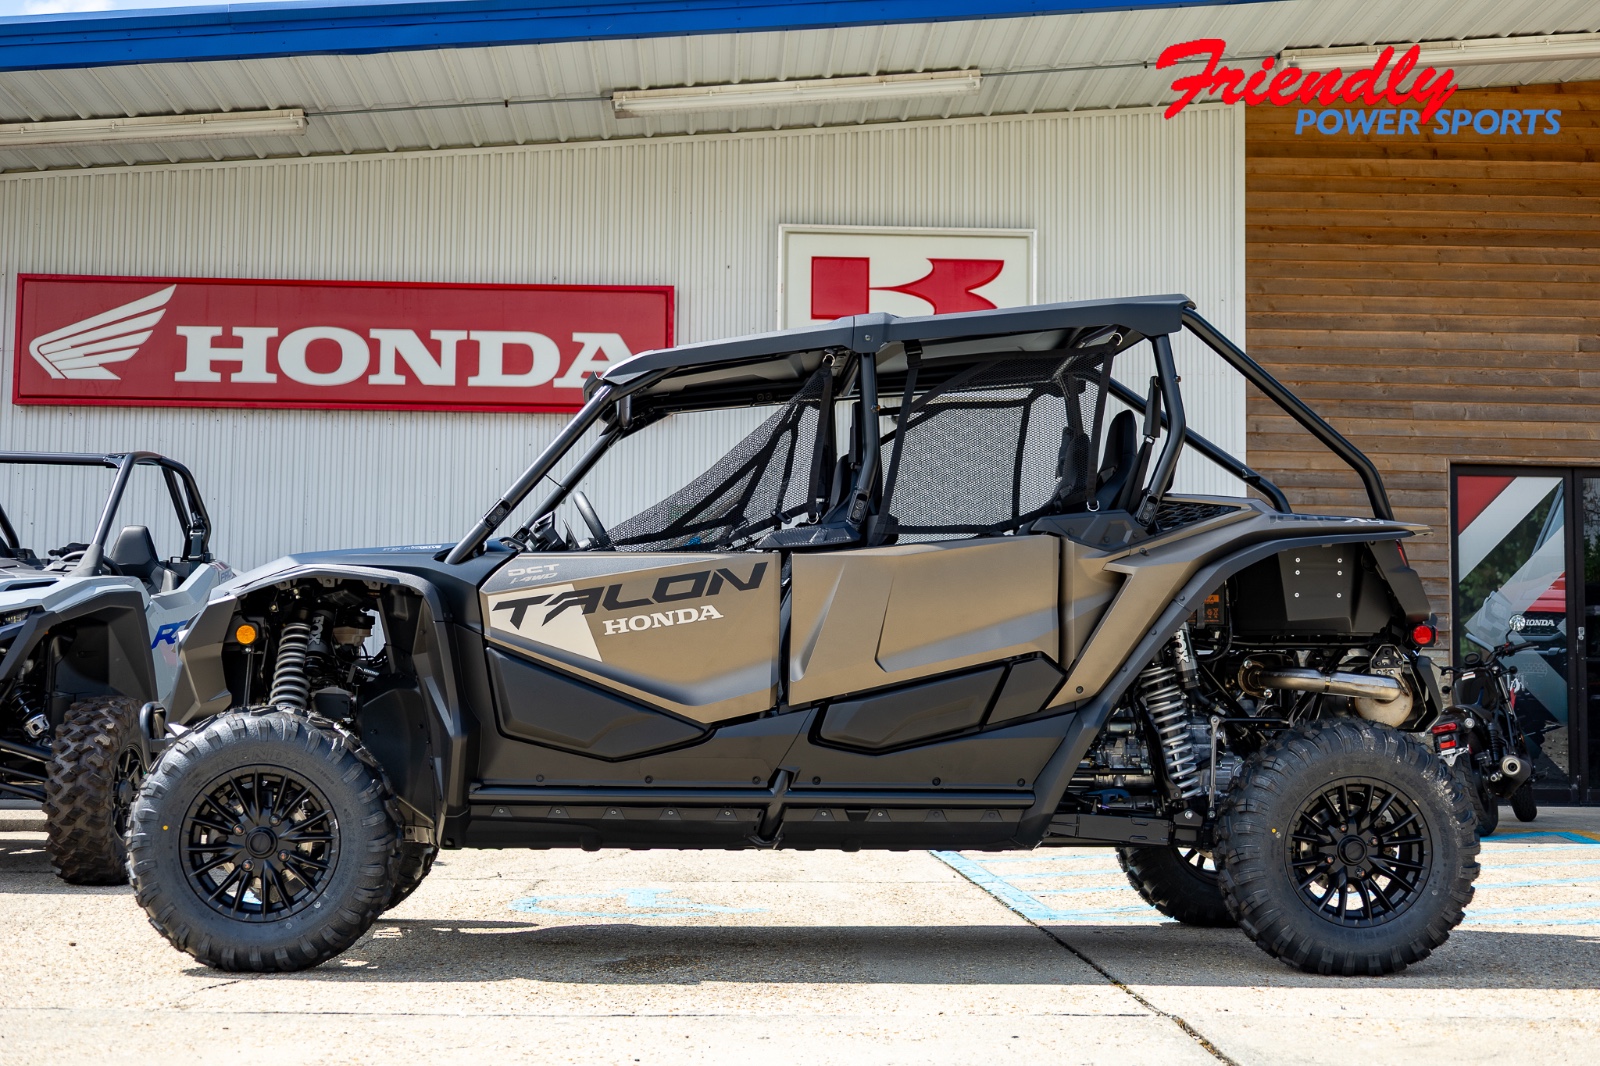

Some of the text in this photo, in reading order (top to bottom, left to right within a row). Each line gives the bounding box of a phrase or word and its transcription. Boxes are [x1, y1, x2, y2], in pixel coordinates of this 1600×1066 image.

[174, 325, 634, 389] HONDA
[508, 563, 560, 577] DCT
[492, 561, 769, 630] TALON
[308, 615, 325, 646] FOX
[602, 605, 724, 635] HONDA
